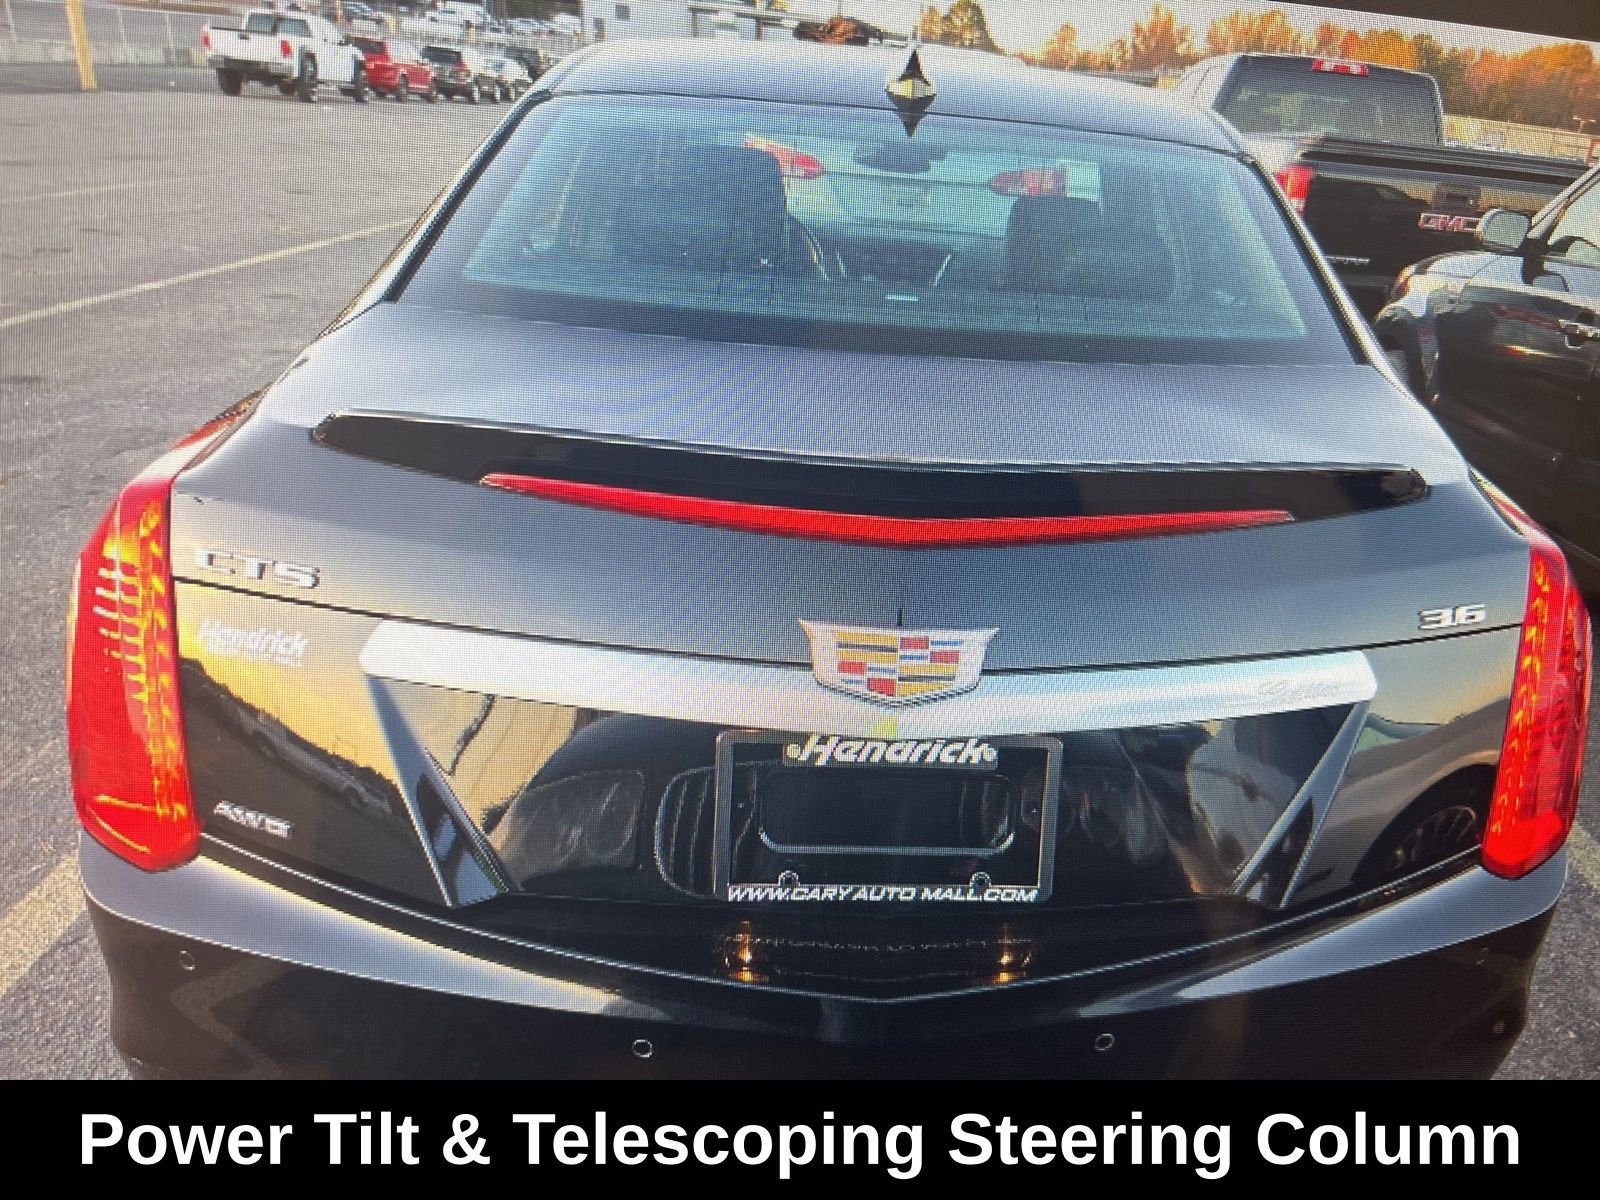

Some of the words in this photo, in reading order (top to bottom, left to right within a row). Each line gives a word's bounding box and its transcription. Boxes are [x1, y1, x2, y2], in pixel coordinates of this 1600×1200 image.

[1418, 211, 1480, 232] GMC
[195, 546, 320, 589] CTS
[196, 616, 309, 660] Hendrick
[797, 735, 983, 766] Hendrick
[921, 887, 1038, 902] MALL.COM
